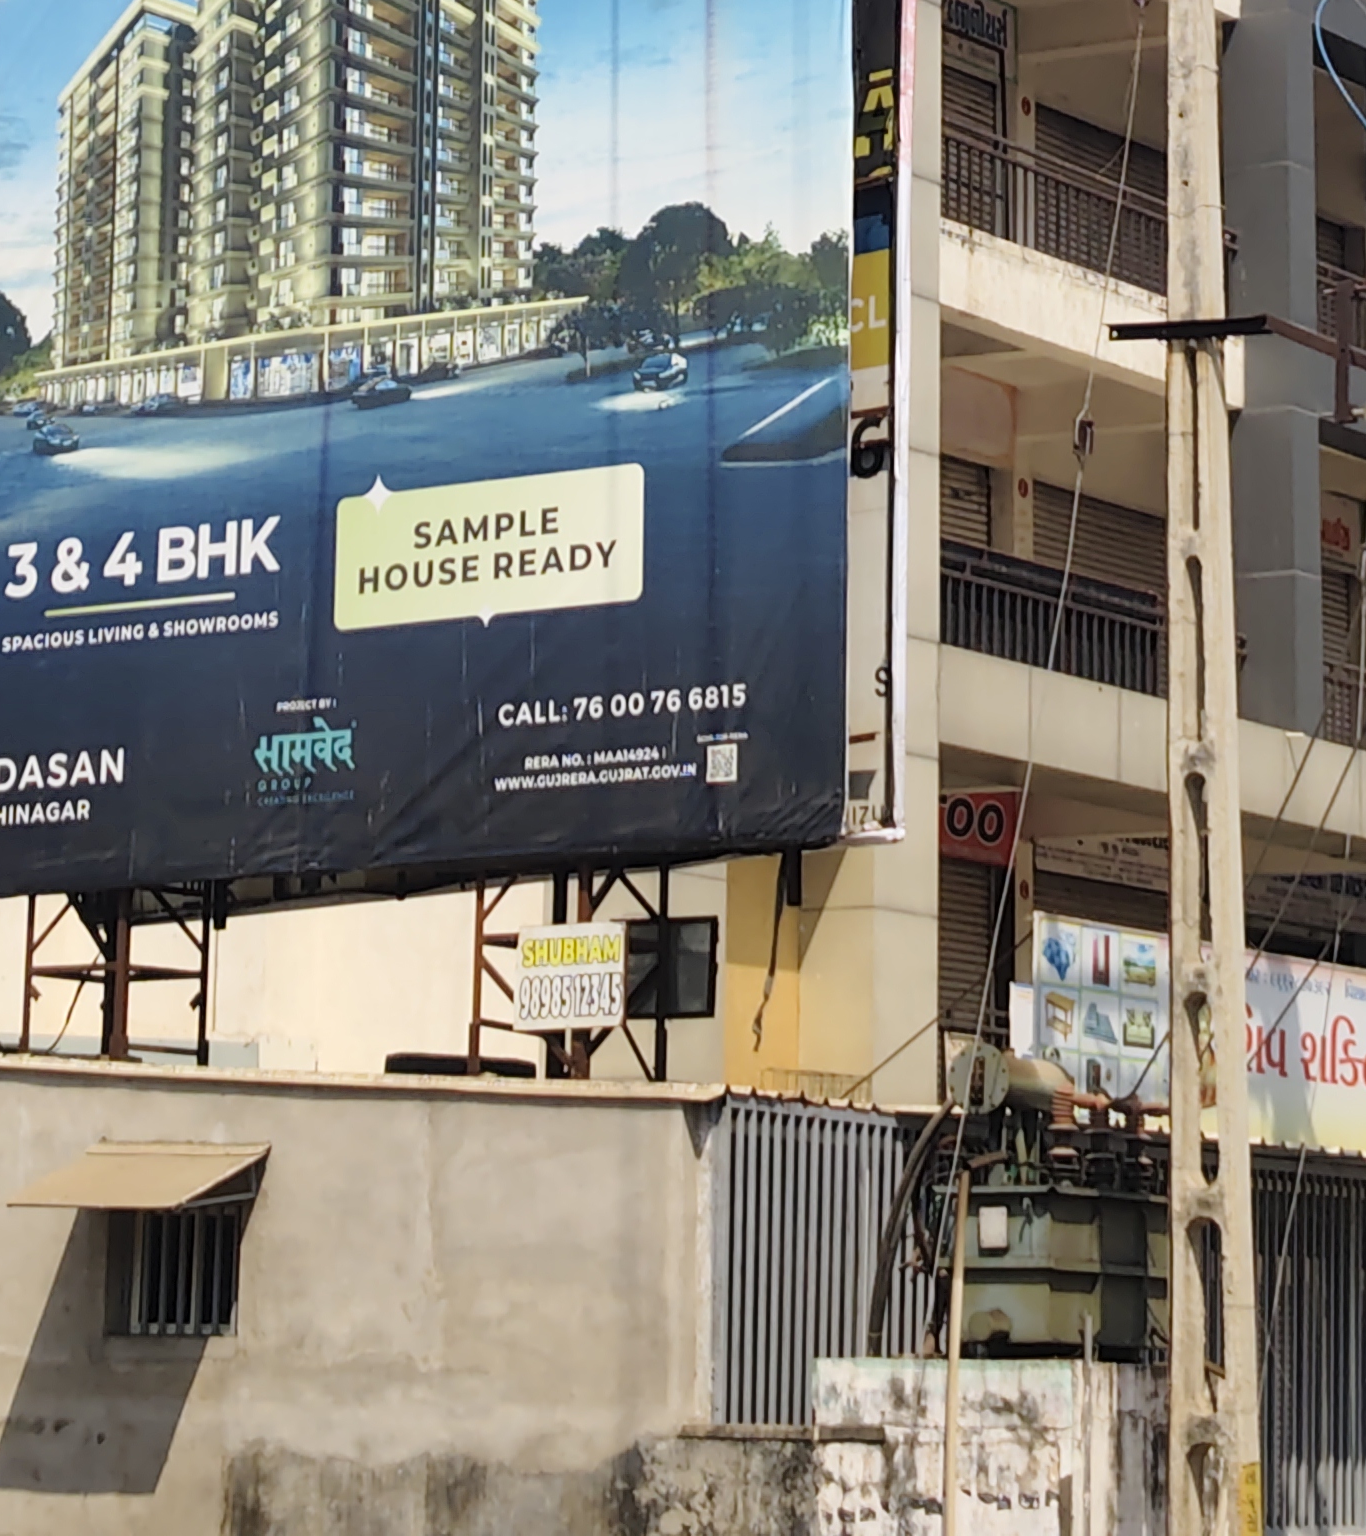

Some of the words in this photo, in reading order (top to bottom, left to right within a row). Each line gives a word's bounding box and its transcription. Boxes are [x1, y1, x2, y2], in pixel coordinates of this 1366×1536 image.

[413, 507, 560, 550] SAMPLE
[5, 541, 38, 599] 3
[51, 537, 90, 594] &
[104, 531, 142, 585] 4
[157, 515, 281, 583] BHK
[358, 555, 480, 595] HOUSE
[493, 539, 617, 581] READY
[1, 629, 84, 653] SPACIOUS
[88, 623, 144, 645] LIVING
[148, 621, 160, 639] &
[163, 610, 279, 638] SHOWROOMS
[498, 699, 568, 728] CALL:
[573, 696, 604, 721] 76
[610, 692, 645, 717] 00
[651, 688, 682, 713] 76
[688, 683, 747, 711] 6815
[254, 716, 355, 776] सामवेद
[524, 753, 559, 771] RERA
[257, 776, 312, 793] GROUP
[521, 935, 621, 968] SHUBHAM
